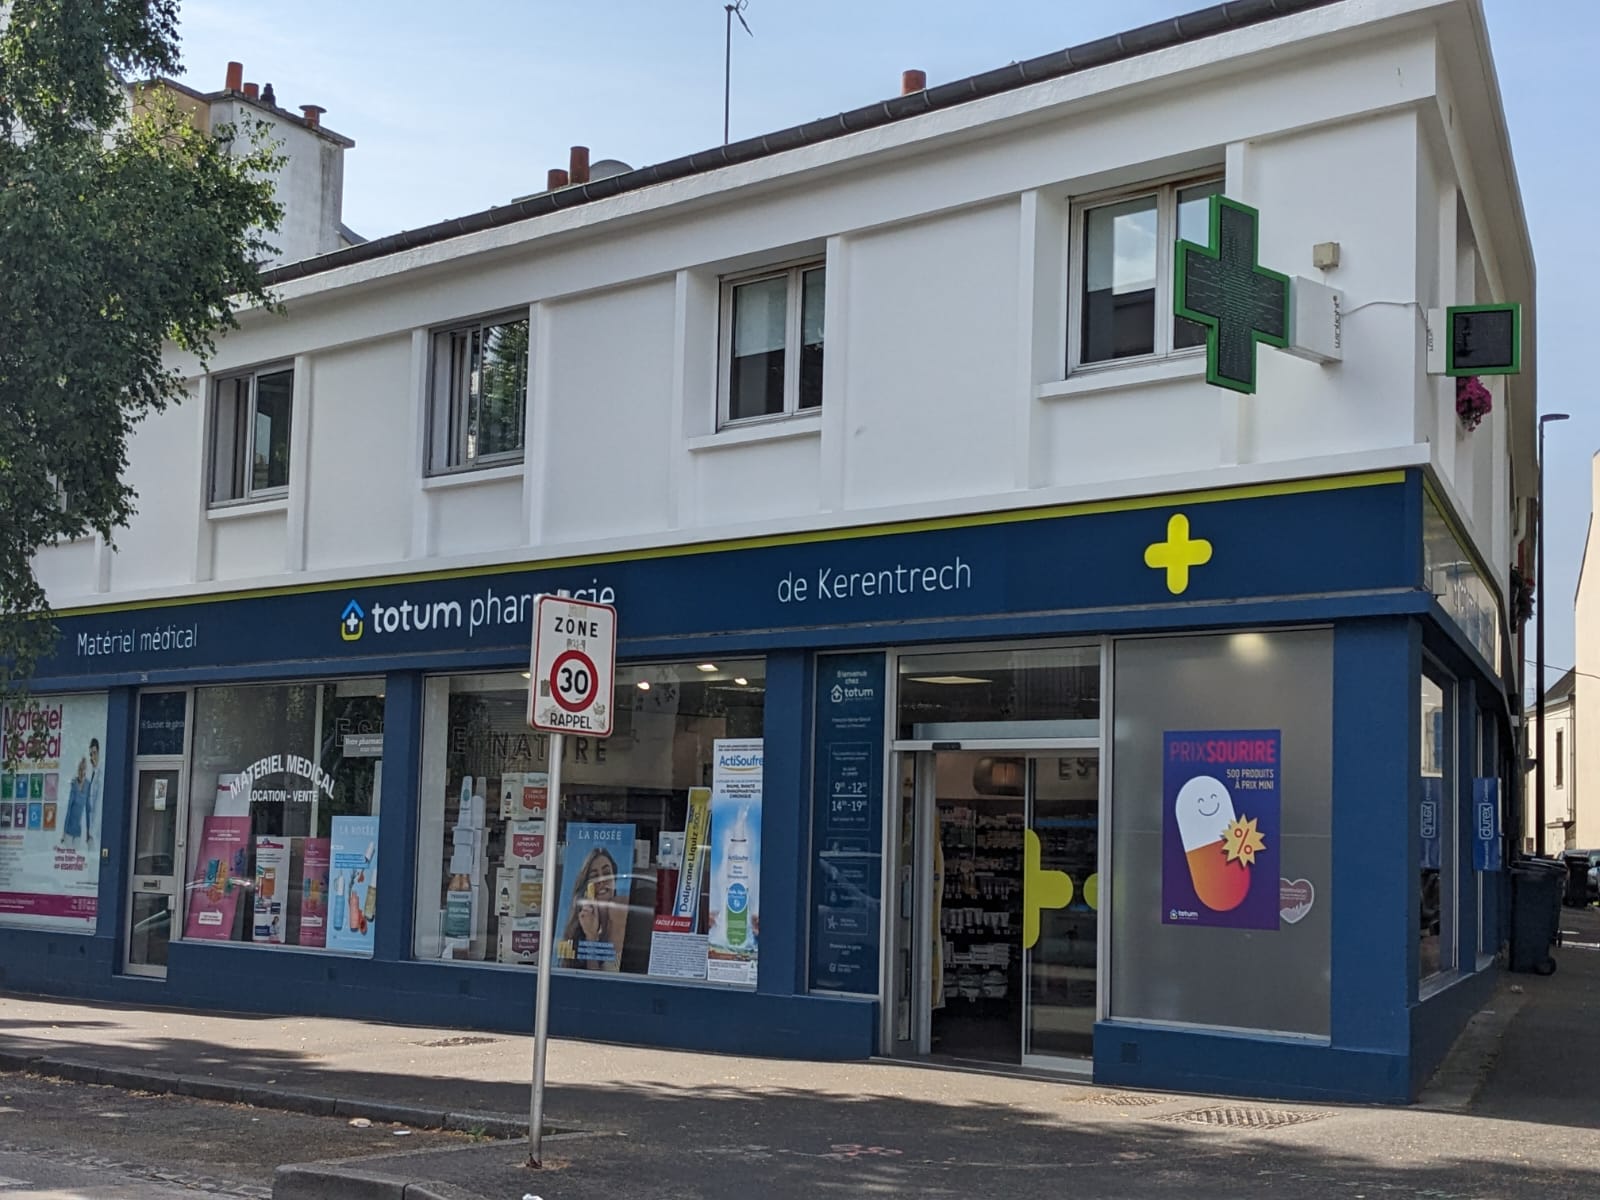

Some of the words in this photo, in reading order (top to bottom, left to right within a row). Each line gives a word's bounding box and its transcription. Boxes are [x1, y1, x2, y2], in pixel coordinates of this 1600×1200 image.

[777, 570, 808, 603] de
[818, 556, 972, 600] Kerentrech
[371, 600, 462, 633] totum
[469, 578, 615, 637] pharcie
[77, 628, 136, 656] Matériel
[140, 622, 198, 651] médical
[554, 616, 599, 638] ZONE
[559, 667, 589, 695] 30
[844, 687, 874, 698] totum
[549, 712, 592, 730] RAPPEL
[492, 730, 607, 765] NATRE
[719, 755, 764, 767] ActiSoufre
[230, 754, 284, 799] MATERIEL
[286, 754, 336, 800] MEDICAL
[1226, 769, 1240, 779] 500
[1241, 769, 1274, 779] PRODUITS
[1242, 780, 1257, 789] PRIX
[1258, 780, 1274, 789] MINI
[249, 790, 287, 802] LOCATION
[293, 790, 319, 802] VENTE
[1480, 804, 1493, 838] durex
[578, 830, 590, 840] LA
[593, 830, 622, 841] ROSÉE
[687, 831, 699, 862] Liquiz
[680, 862, 695, 912] Doliprane
